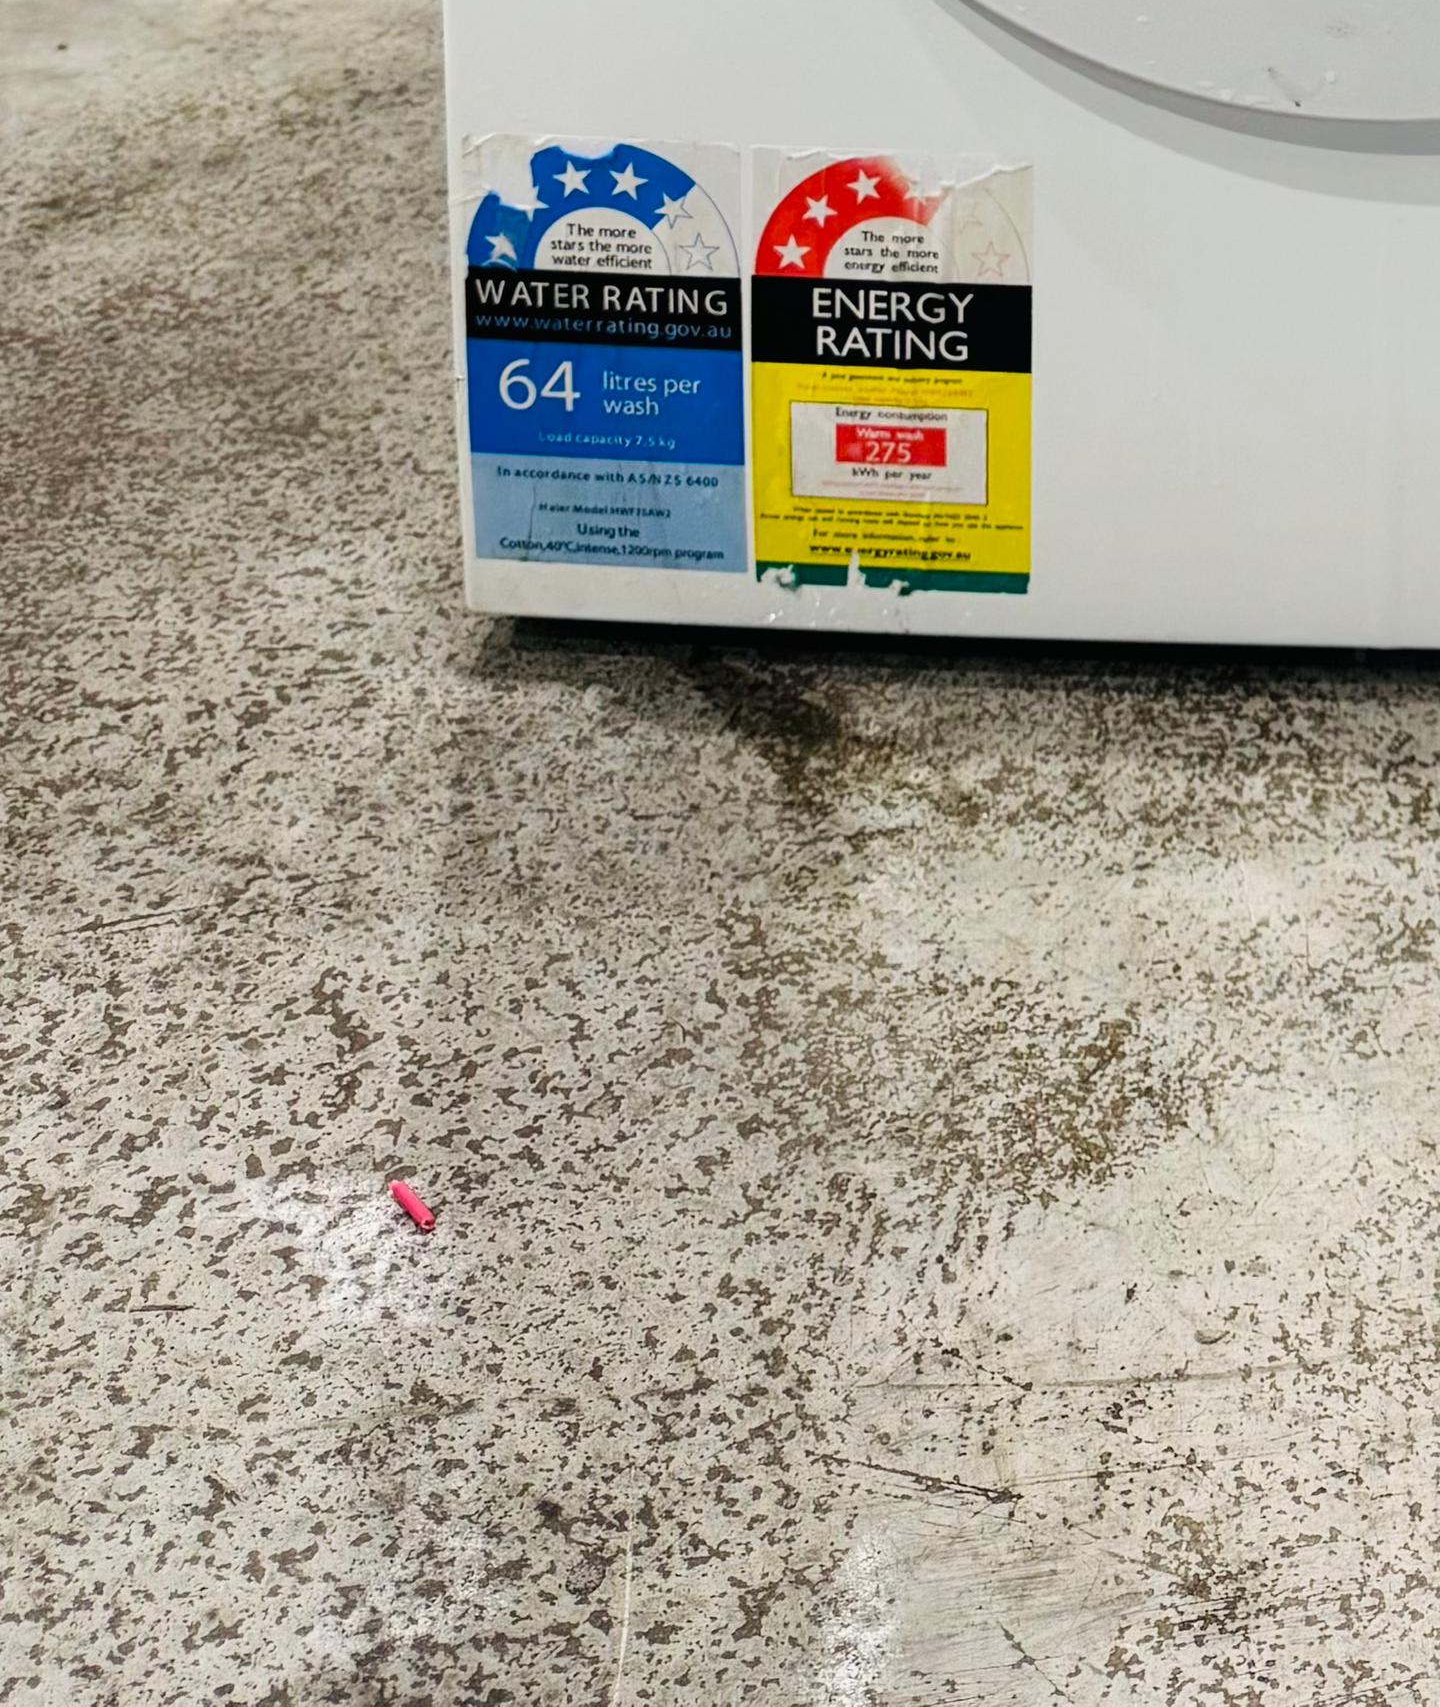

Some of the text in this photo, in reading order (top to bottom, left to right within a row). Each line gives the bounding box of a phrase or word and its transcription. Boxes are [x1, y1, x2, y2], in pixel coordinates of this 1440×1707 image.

[567, 223, 637, 238] The more
[862, 230, 925, 244] The more
[551, 239, 653, 254] stars the more
[844, 246, 940, 260] stars the more
[552, 255, 653, 269] water efficient
[844, 261, 939, 274] energy efficient
[475, 278, 728, 316] WATER RATING
[812, 287, 975, 324] ENERGY
[475, 315, 732, 340] www.waterrating.gov.au
[816, 325, 969, 362] RATING
[499, 358, 582, 412] 64
[602, 370, 701, 397] litres per
[603, 396, 659, 416] wash
[835, 407, 948, 423] Energy consumption
[538, 431, 572, 443] Load
[575, 433, 632, 447] capacity
[865, 440, 912, 463] 275
[514, 468, 591, 482] accordance
[595, 471, 624, 484] with
[686, 475, 719, 488] 6400
[852, 467, 933, 481] kWh per year
[577, 523, 640, 538] Using the
[674, 548, 725, 561] program
[809, 545, 971, 561] www.eergyrating.gov.au
